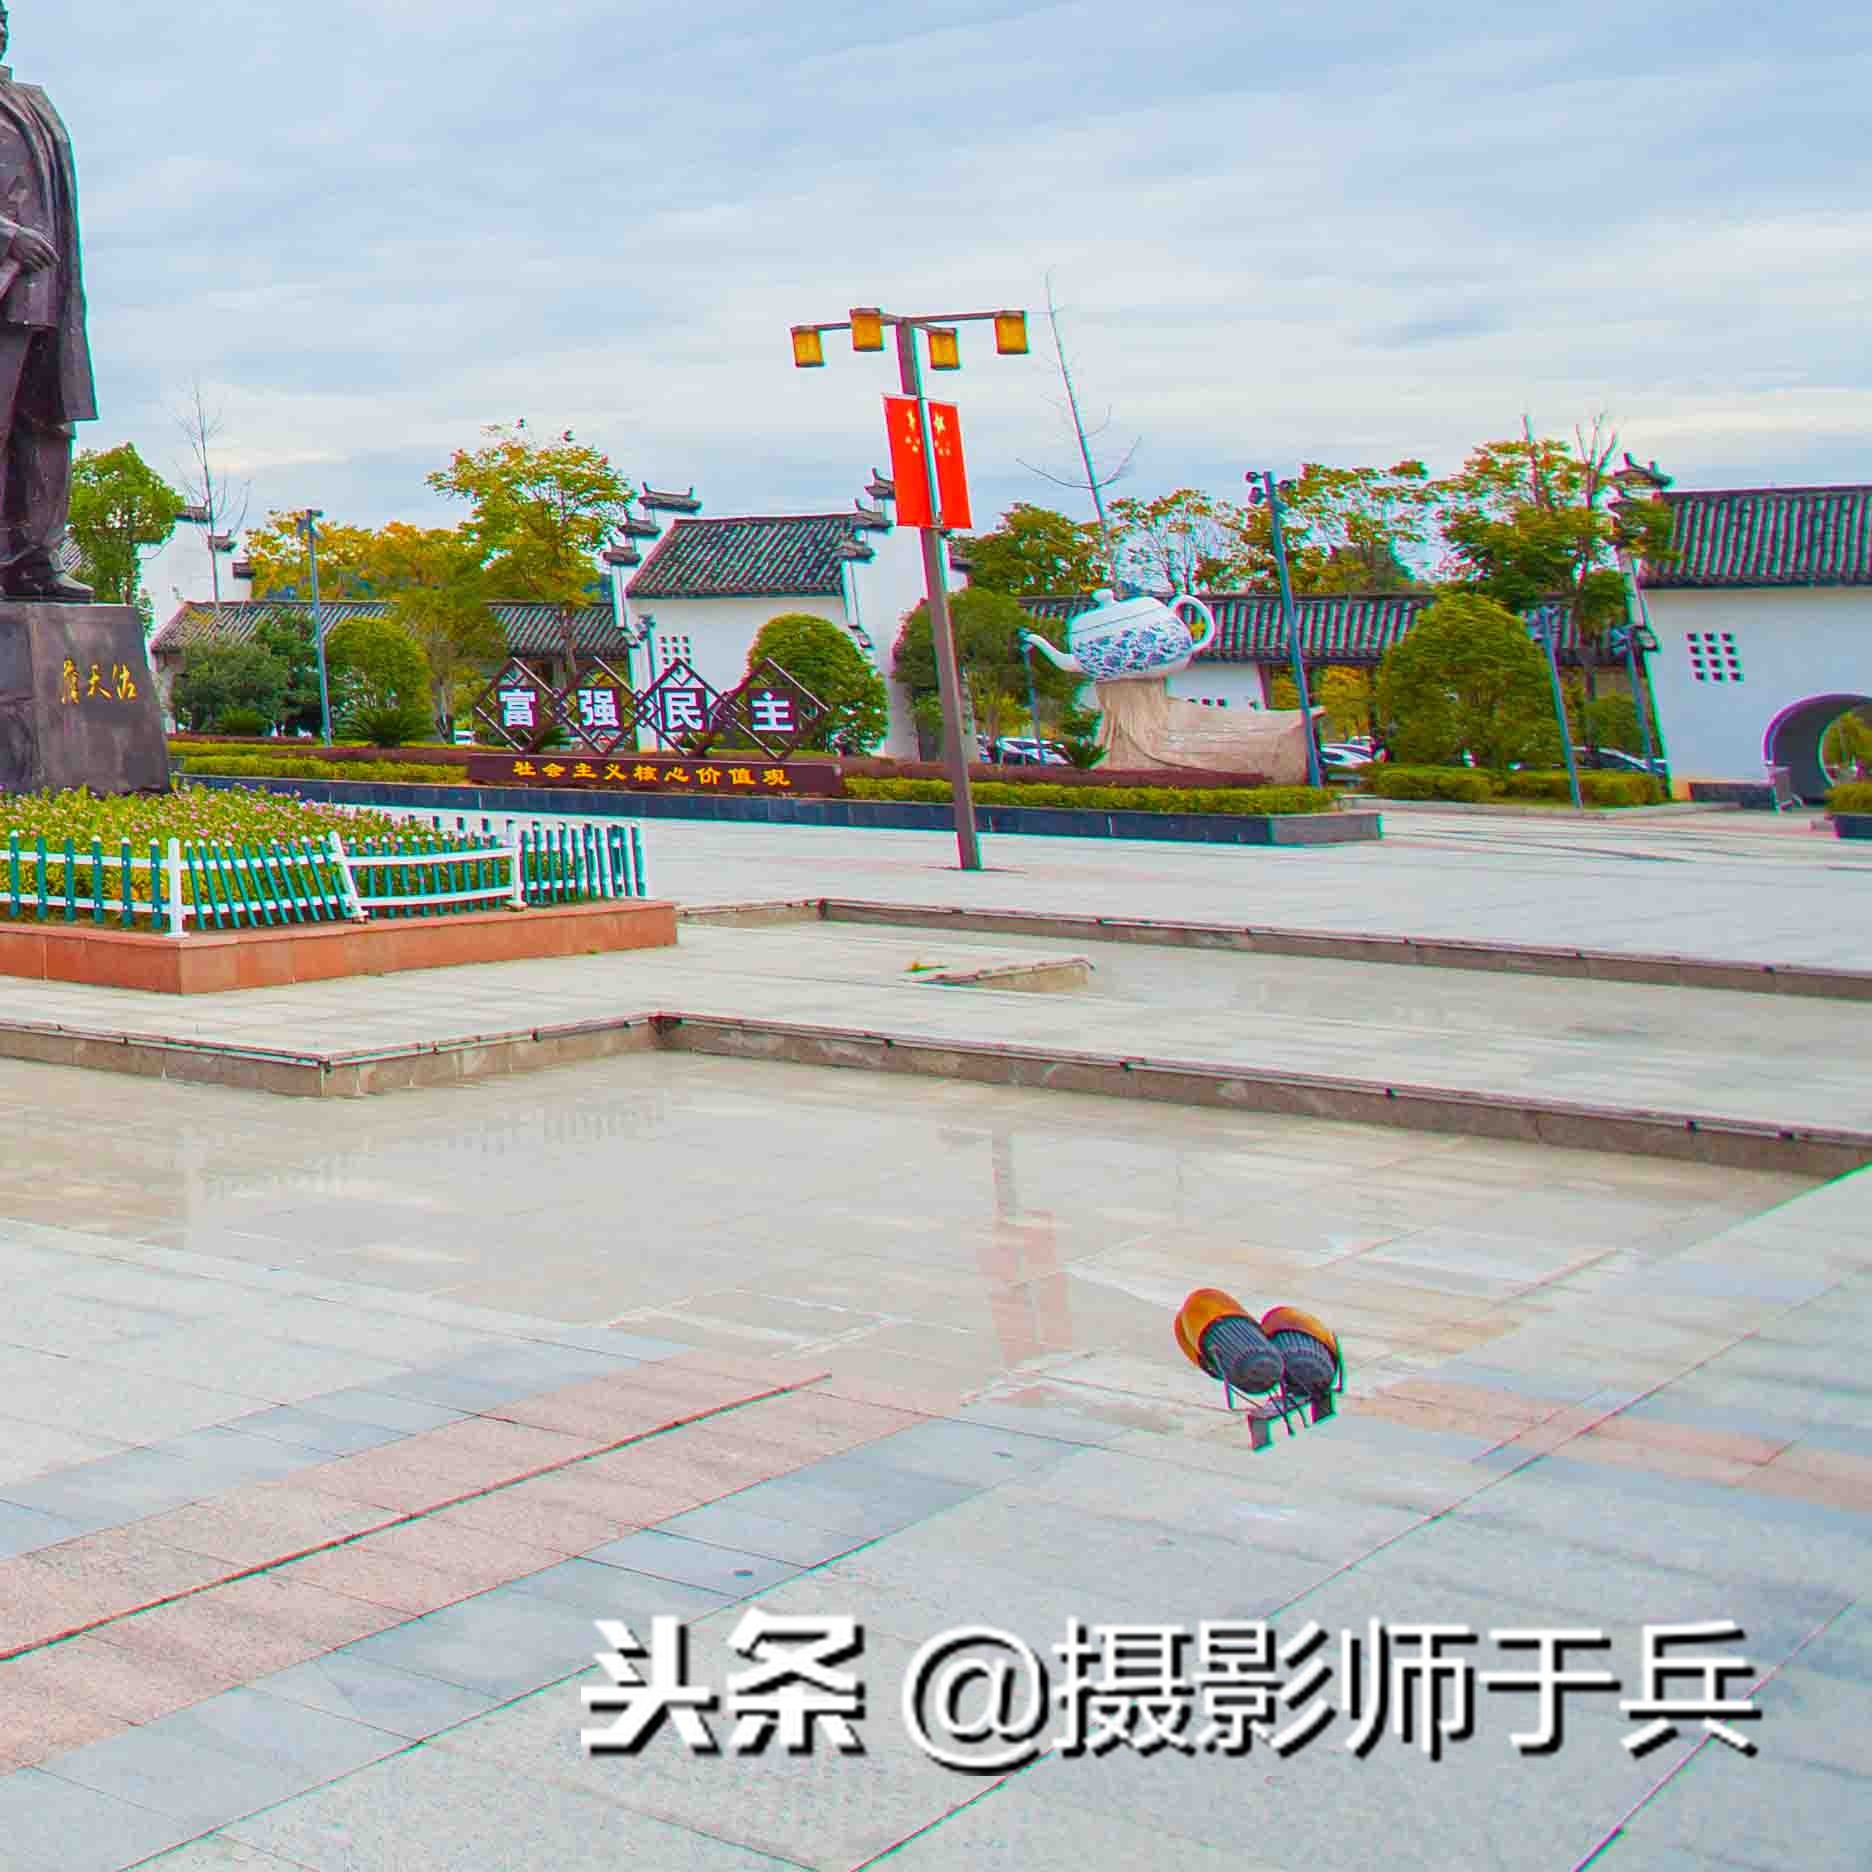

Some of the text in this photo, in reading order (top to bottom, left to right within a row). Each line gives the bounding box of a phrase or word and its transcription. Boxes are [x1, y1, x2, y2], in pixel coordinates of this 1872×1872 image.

[498, 687, 795, 732] 富强民主
[511, 760, 792, 787] 社会主义核心价值观
